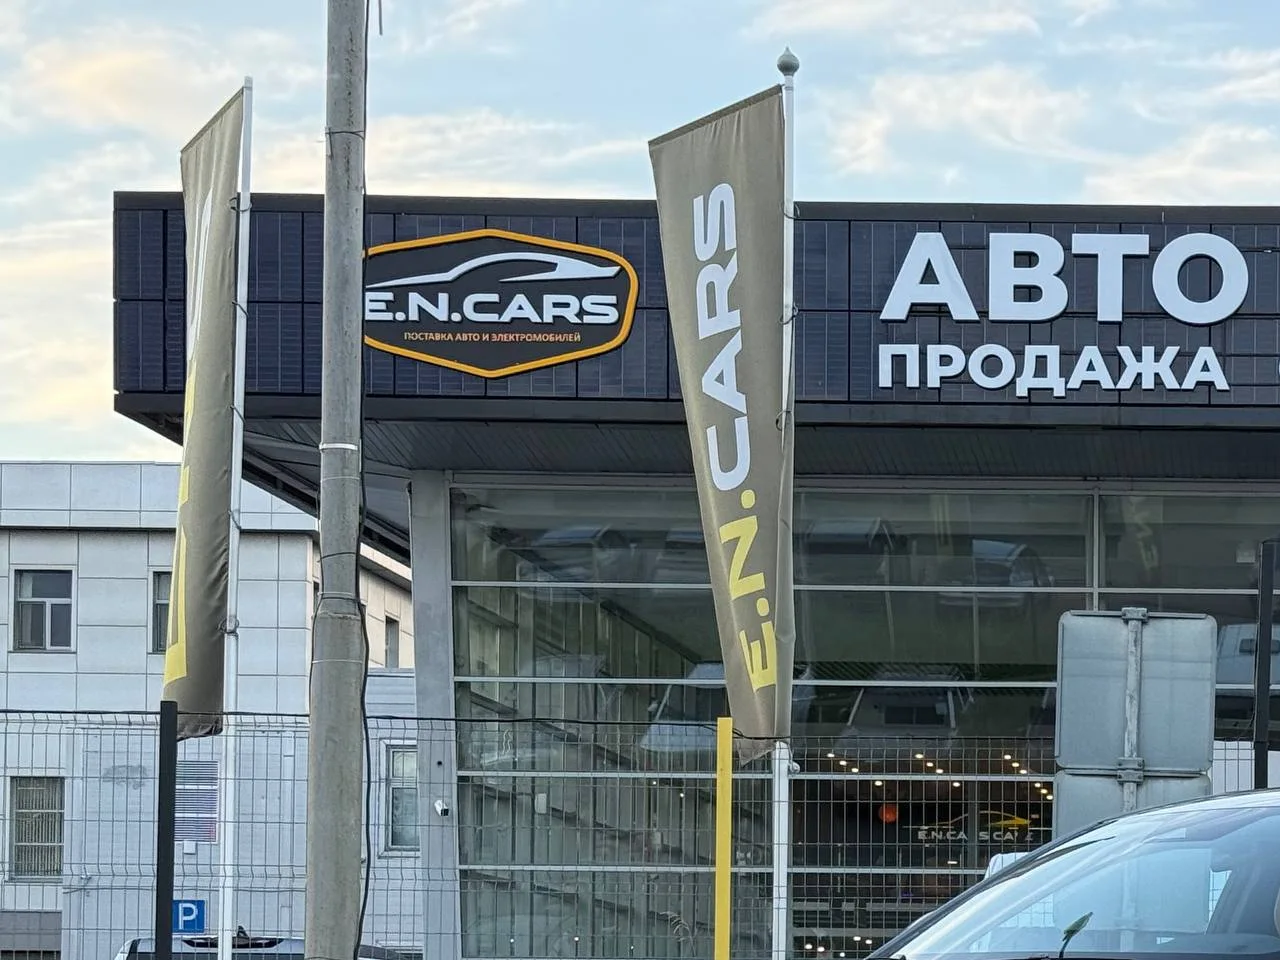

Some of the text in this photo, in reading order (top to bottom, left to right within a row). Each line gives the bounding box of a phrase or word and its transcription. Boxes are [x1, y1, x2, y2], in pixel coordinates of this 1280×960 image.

[879, 232, 1249, 325] АВТО
[365, 292, 619, 324] E.N.CARS
[404, 332, 581, 342] ПОСТАВКА АВТО И ЭЛЕКТРОМОБИЛЕЙ
[878, 344, 1230, 397] ПРОДАЖА
[693, 183, 777, 693] E.N.CARS
[918, 831, 989, 840] E.N.CAS
[179, 903, 198, 930] P
